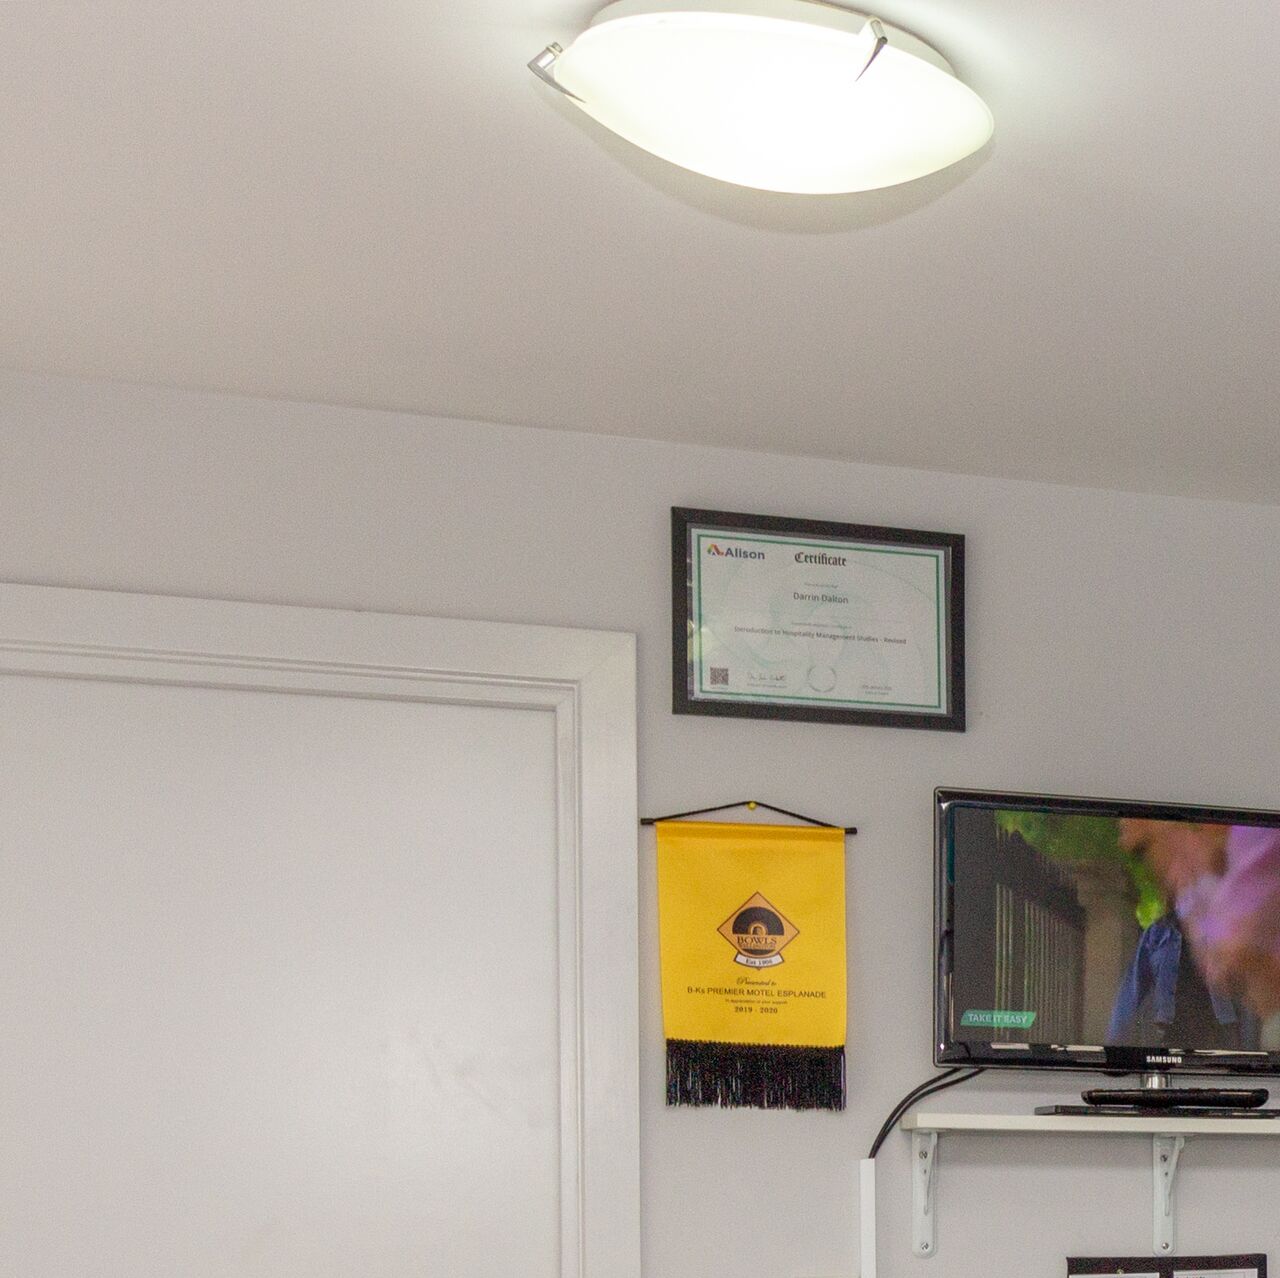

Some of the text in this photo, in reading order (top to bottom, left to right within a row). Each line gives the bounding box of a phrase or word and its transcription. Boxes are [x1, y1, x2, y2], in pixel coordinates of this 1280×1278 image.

[724, 547, 766, 560] Alison
[794, 551, 847, 567] Certificate
[793, 592, 849, 604] Darrin Dalton
[816, 632, 855, 641] Management
[737, 935, 777, 945] BOWLS
[707, 987, 746, 996] PREMIER
[746, 988, 775, 997] MOTEL
[777, 989, 827, 999] ESPLANADE
[968, 1013, 1028, 1024] TAKE IT EASY
[1146, 1055, 1182, 1064] SAMSUNG
